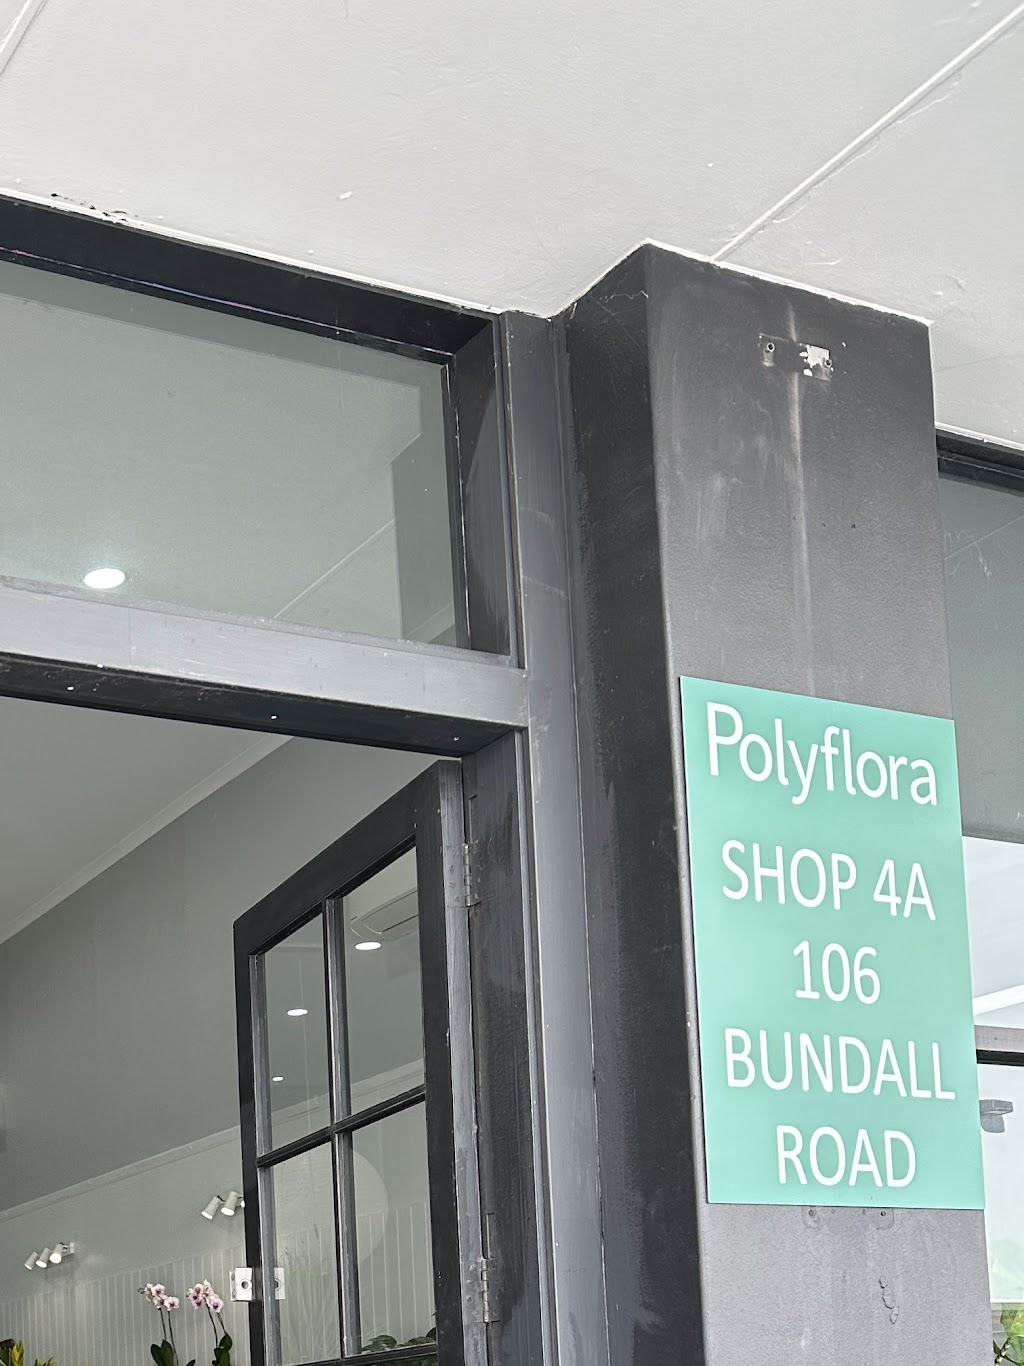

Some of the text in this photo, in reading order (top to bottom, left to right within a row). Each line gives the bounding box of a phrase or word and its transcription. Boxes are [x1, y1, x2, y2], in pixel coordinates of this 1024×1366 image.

[706, 701, 938, 805] Polyflora
[721, 839, 937, 921] SHOP 4A
[793, 940, 881, 1004] 106
[724, 1027, 956, 1100] BUNDALL
[776, 1124, 916, 1188] ROAD
